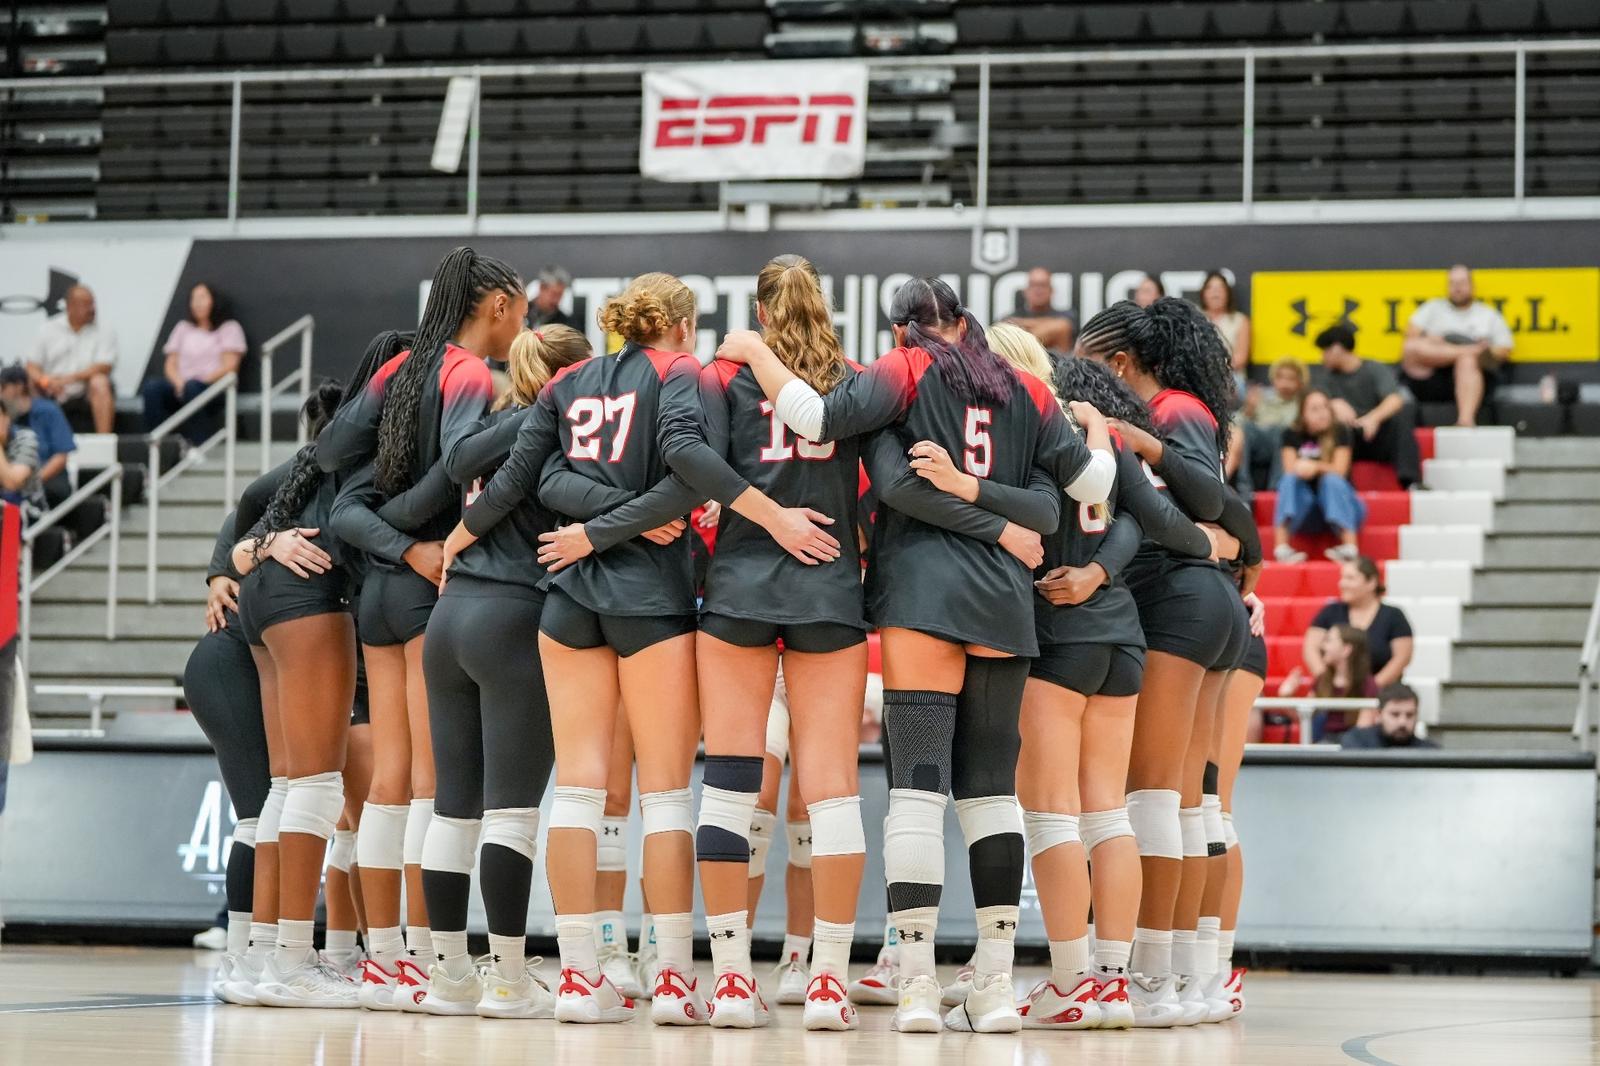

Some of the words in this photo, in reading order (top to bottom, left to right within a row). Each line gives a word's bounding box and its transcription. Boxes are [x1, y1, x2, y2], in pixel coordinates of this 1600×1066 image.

[654, 94, 857, 148] ESPN
[564, 389, 638, 464] 27
[758, 399, 837, 463] 1
[963, 405, 993, 480] 5
